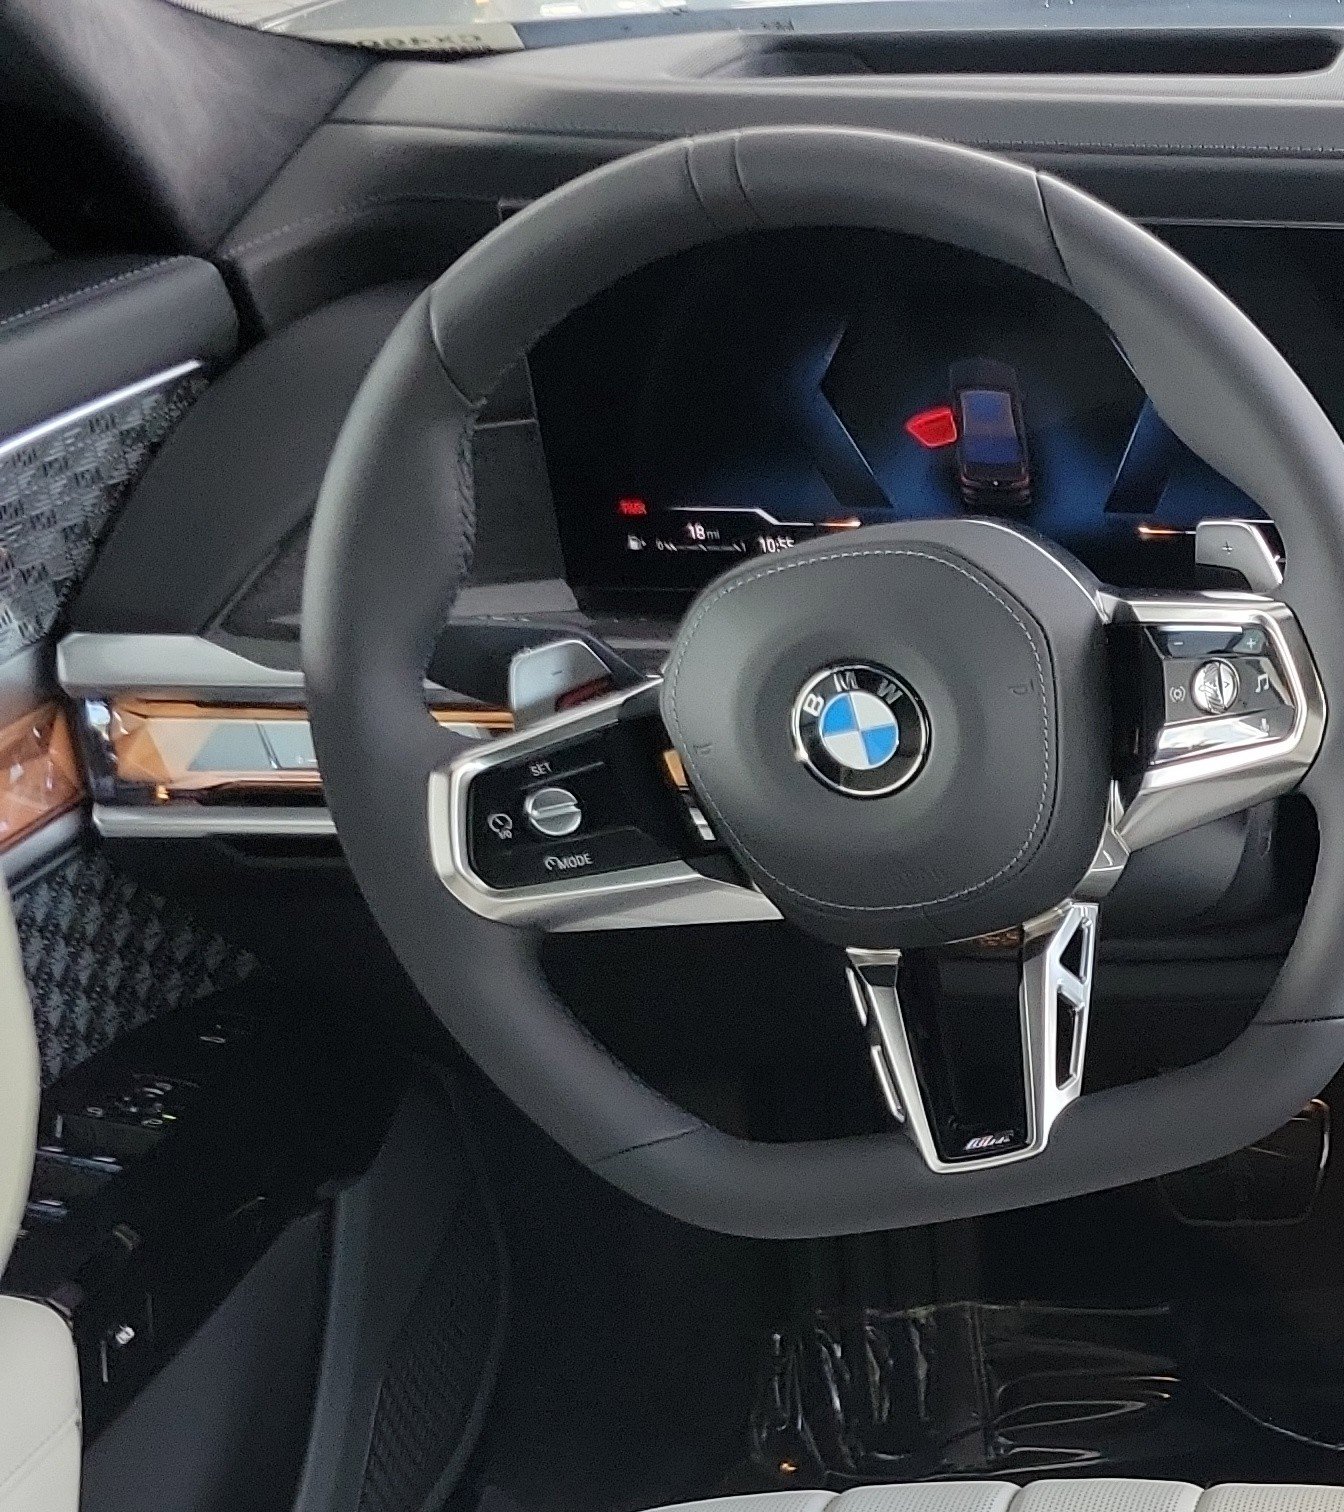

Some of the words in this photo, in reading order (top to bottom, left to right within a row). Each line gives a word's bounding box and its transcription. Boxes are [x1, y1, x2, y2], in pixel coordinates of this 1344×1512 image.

[686, 522, 706, 540] 18
[707, 529, 721, 540] mi
[803, 671, 903, 716] BMW
[530, 762, 553, 776] SET
[555, 852, 594, 869] MODE
